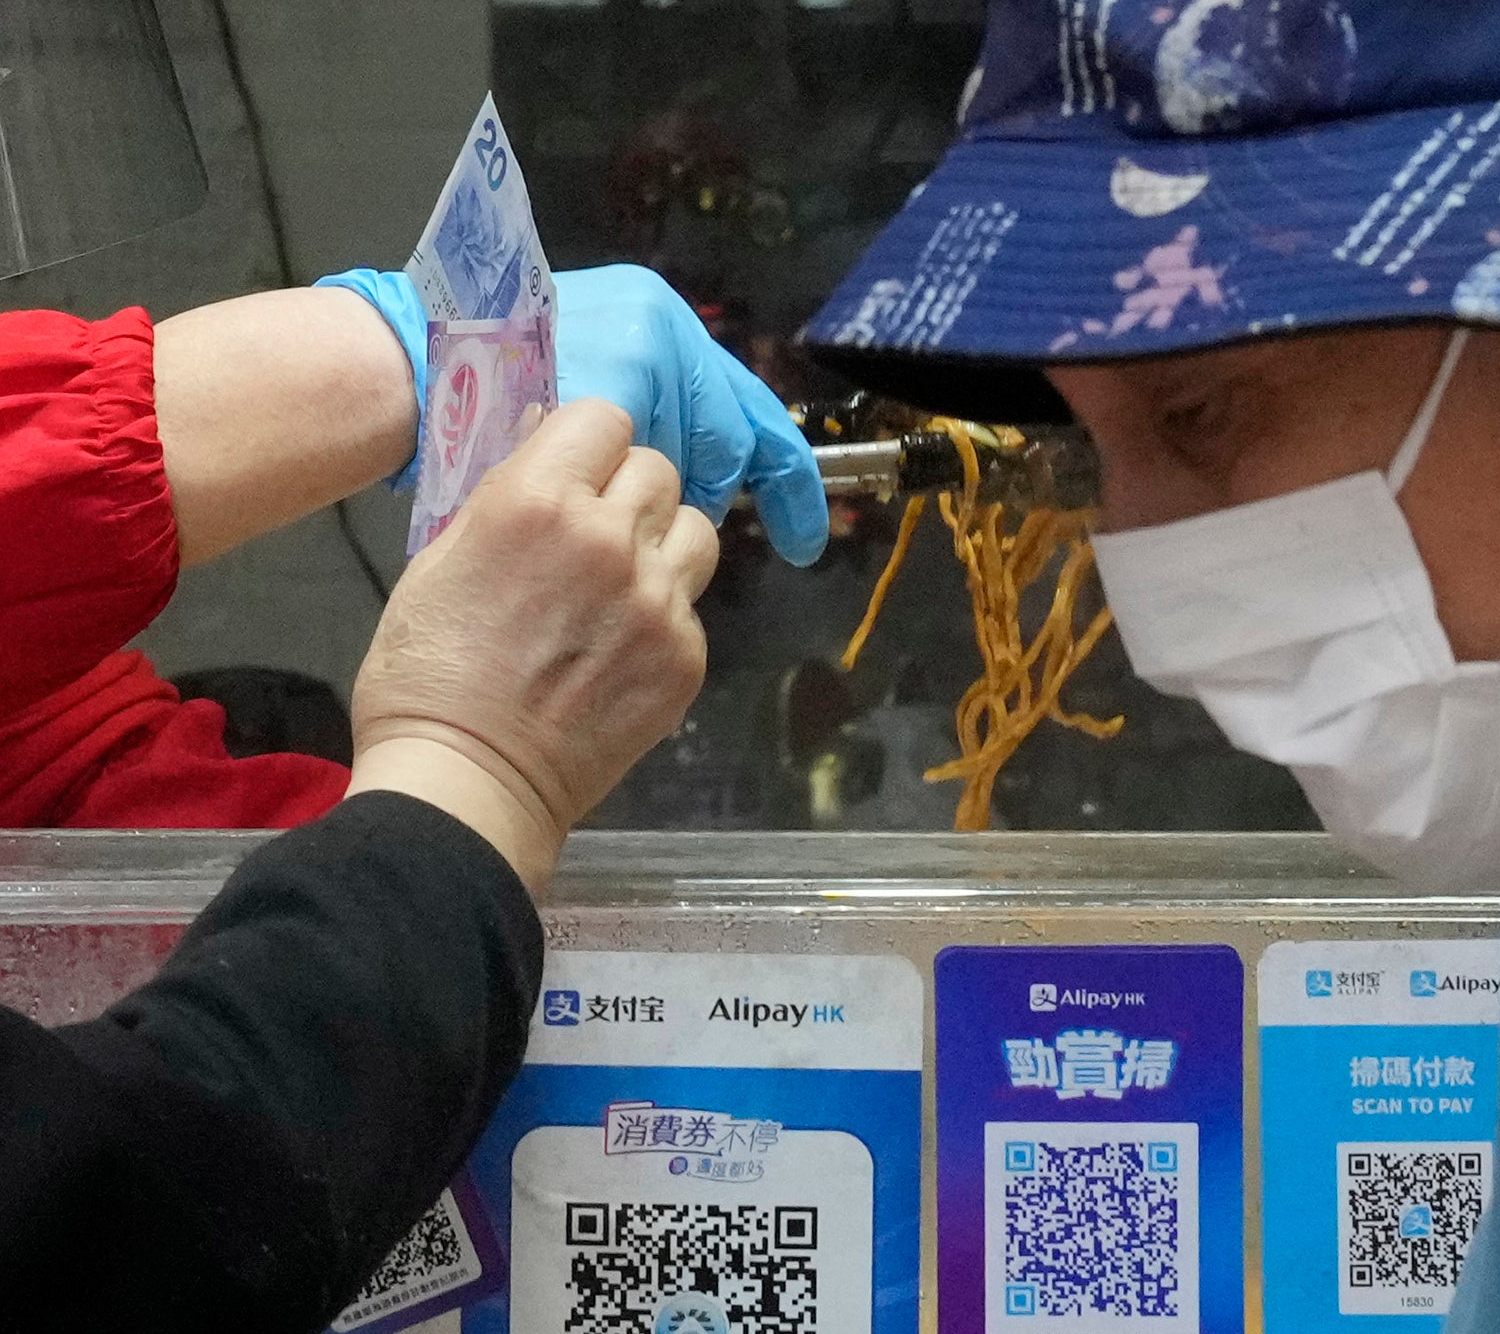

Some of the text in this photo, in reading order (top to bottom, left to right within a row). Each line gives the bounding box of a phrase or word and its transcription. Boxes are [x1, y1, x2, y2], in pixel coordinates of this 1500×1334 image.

[475, 117, 507, 192] 20
[585, 995, 665, 1023] 支付宝
[1004, 1029, 1176, 1100] 勁賞掃
[1350, 1055, 1476, 1088] 掃碼付款
[1352, 1098, 1474, 1114] SCAN TO PAY
[1400, 1296, 1434, 1308] 15830
